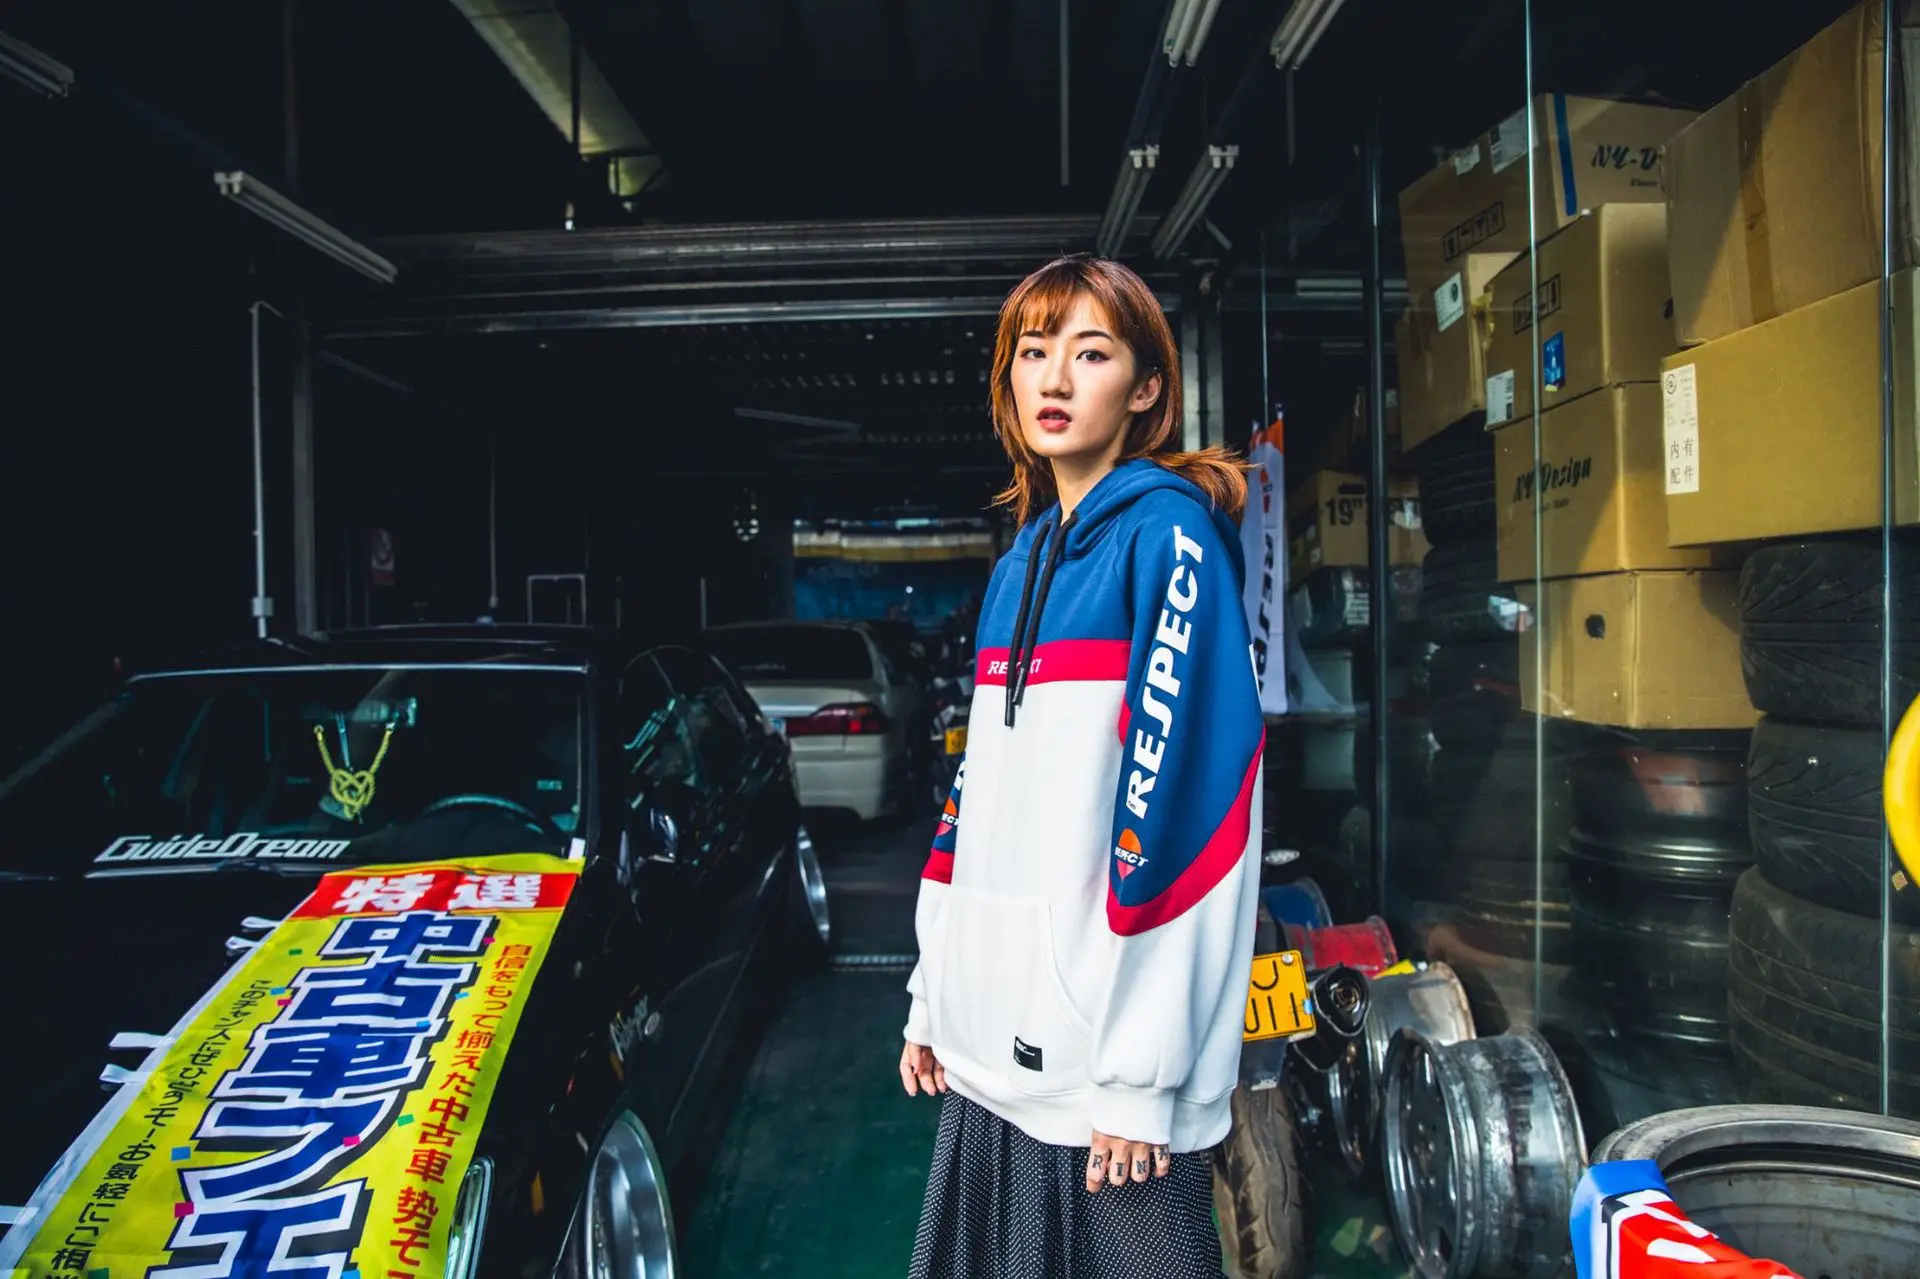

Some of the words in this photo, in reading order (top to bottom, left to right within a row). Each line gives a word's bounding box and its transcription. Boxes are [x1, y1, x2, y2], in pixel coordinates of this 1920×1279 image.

[1125, 525, 1203, 820] RESPECT
[95, 832, 351, 862] GuideDream
[333, 873, 543, 913] 特選
